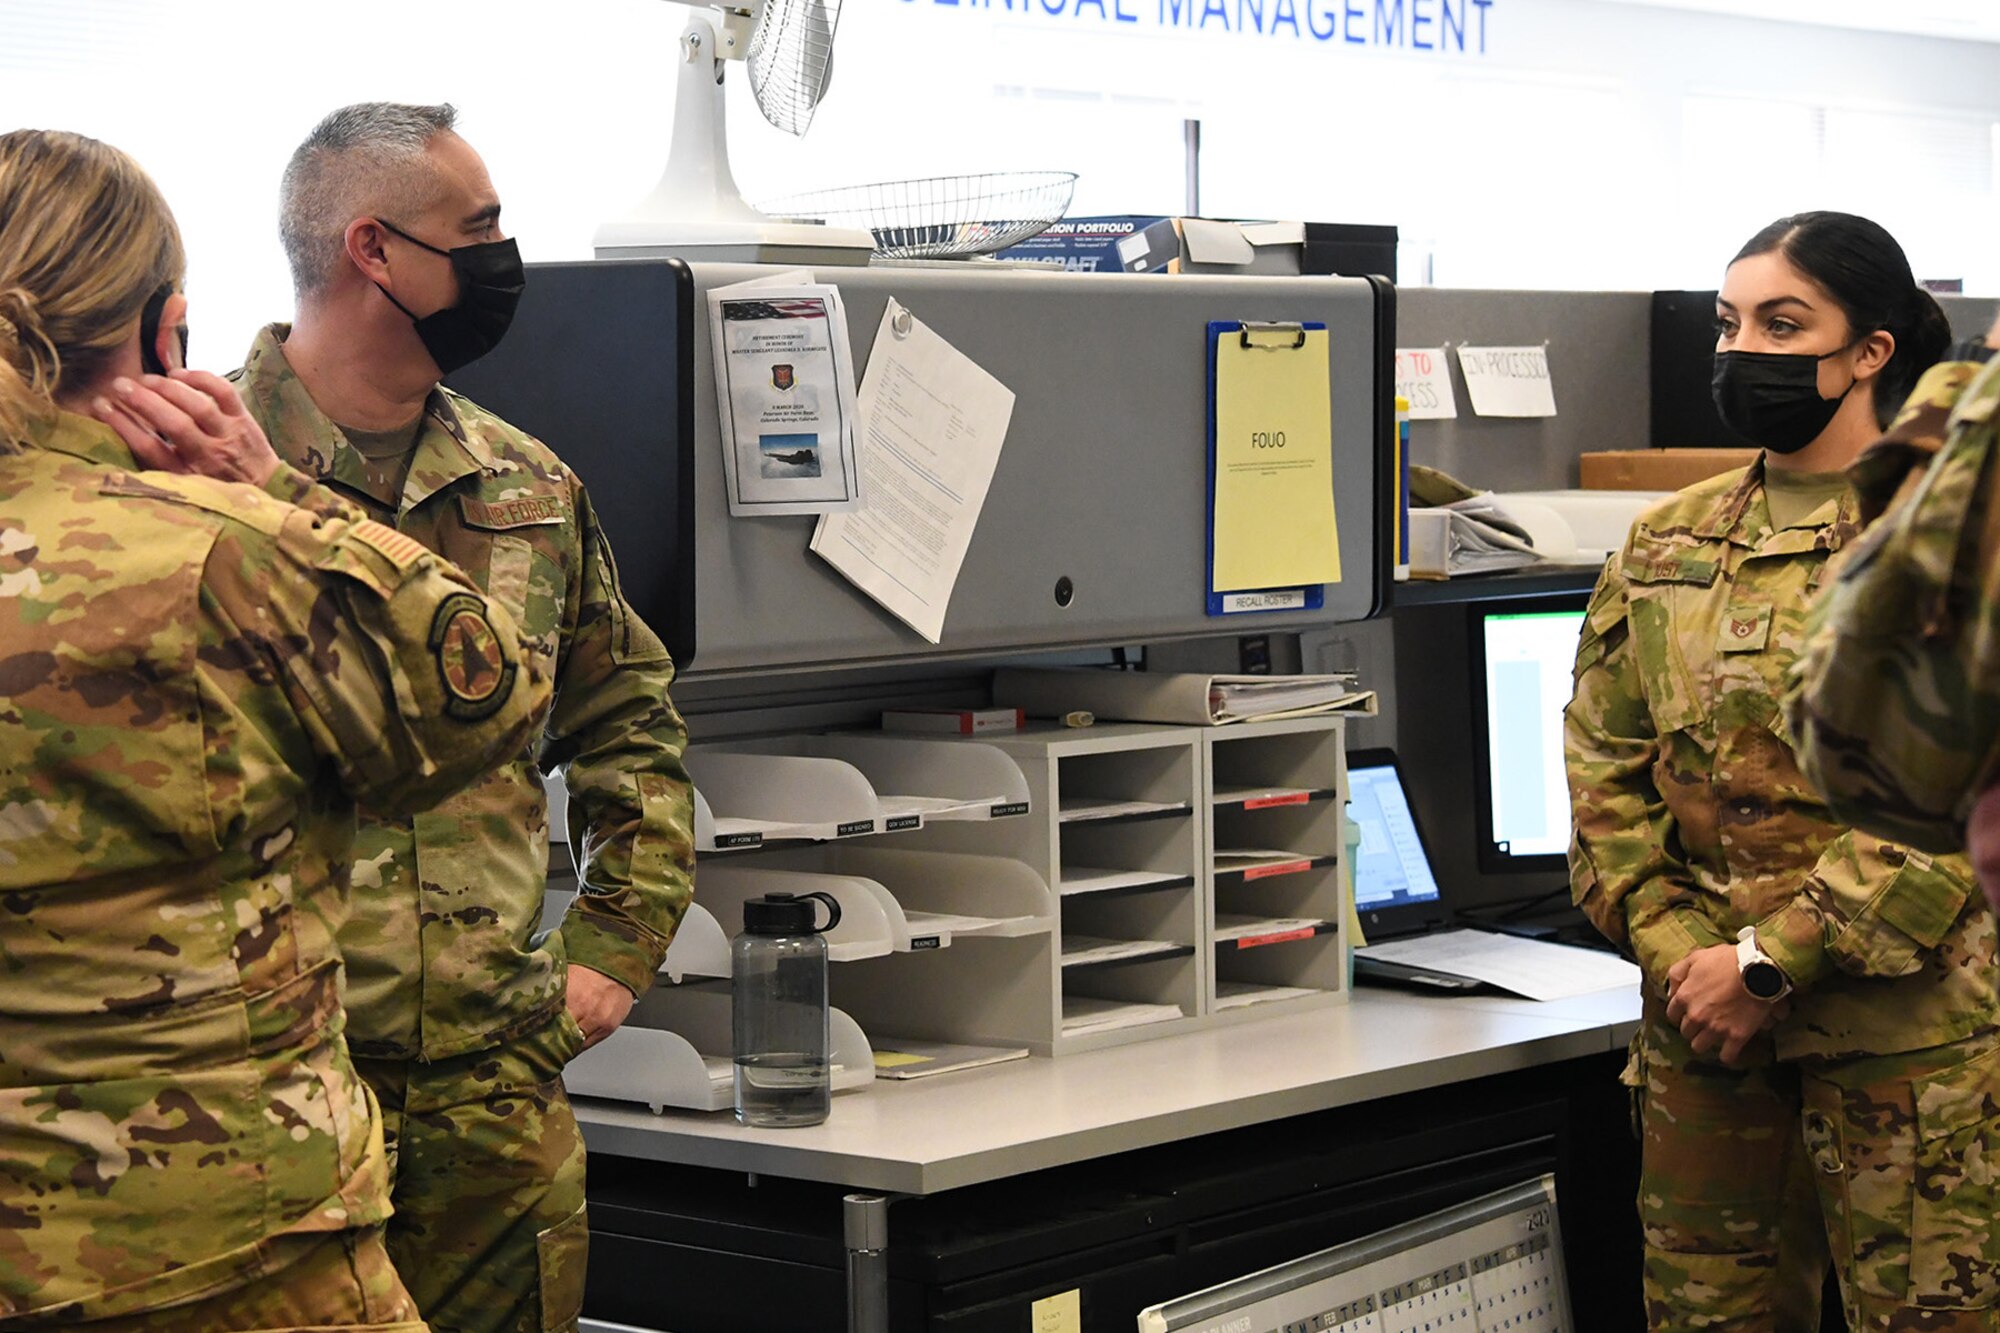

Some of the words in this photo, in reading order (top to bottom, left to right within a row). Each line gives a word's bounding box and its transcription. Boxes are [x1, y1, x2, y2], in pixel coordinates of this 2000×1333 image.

[1158, 0, 1492, 54] MANAGEMENT
[1076, 222, 1136, 234] PORTFOLIO
[1408, 351, 1432, 378] TO
[1252, 431, 1286, 449] FOUO
[507, 498, 560, 524] FORCE
[1236, 595, 1263, 608] RECALL
[1264, 593, 1294, 606] ROSTER
[1418, 1277, 1432, 1291] MAR
[1323, 1311, 1337, 1327] FEB
